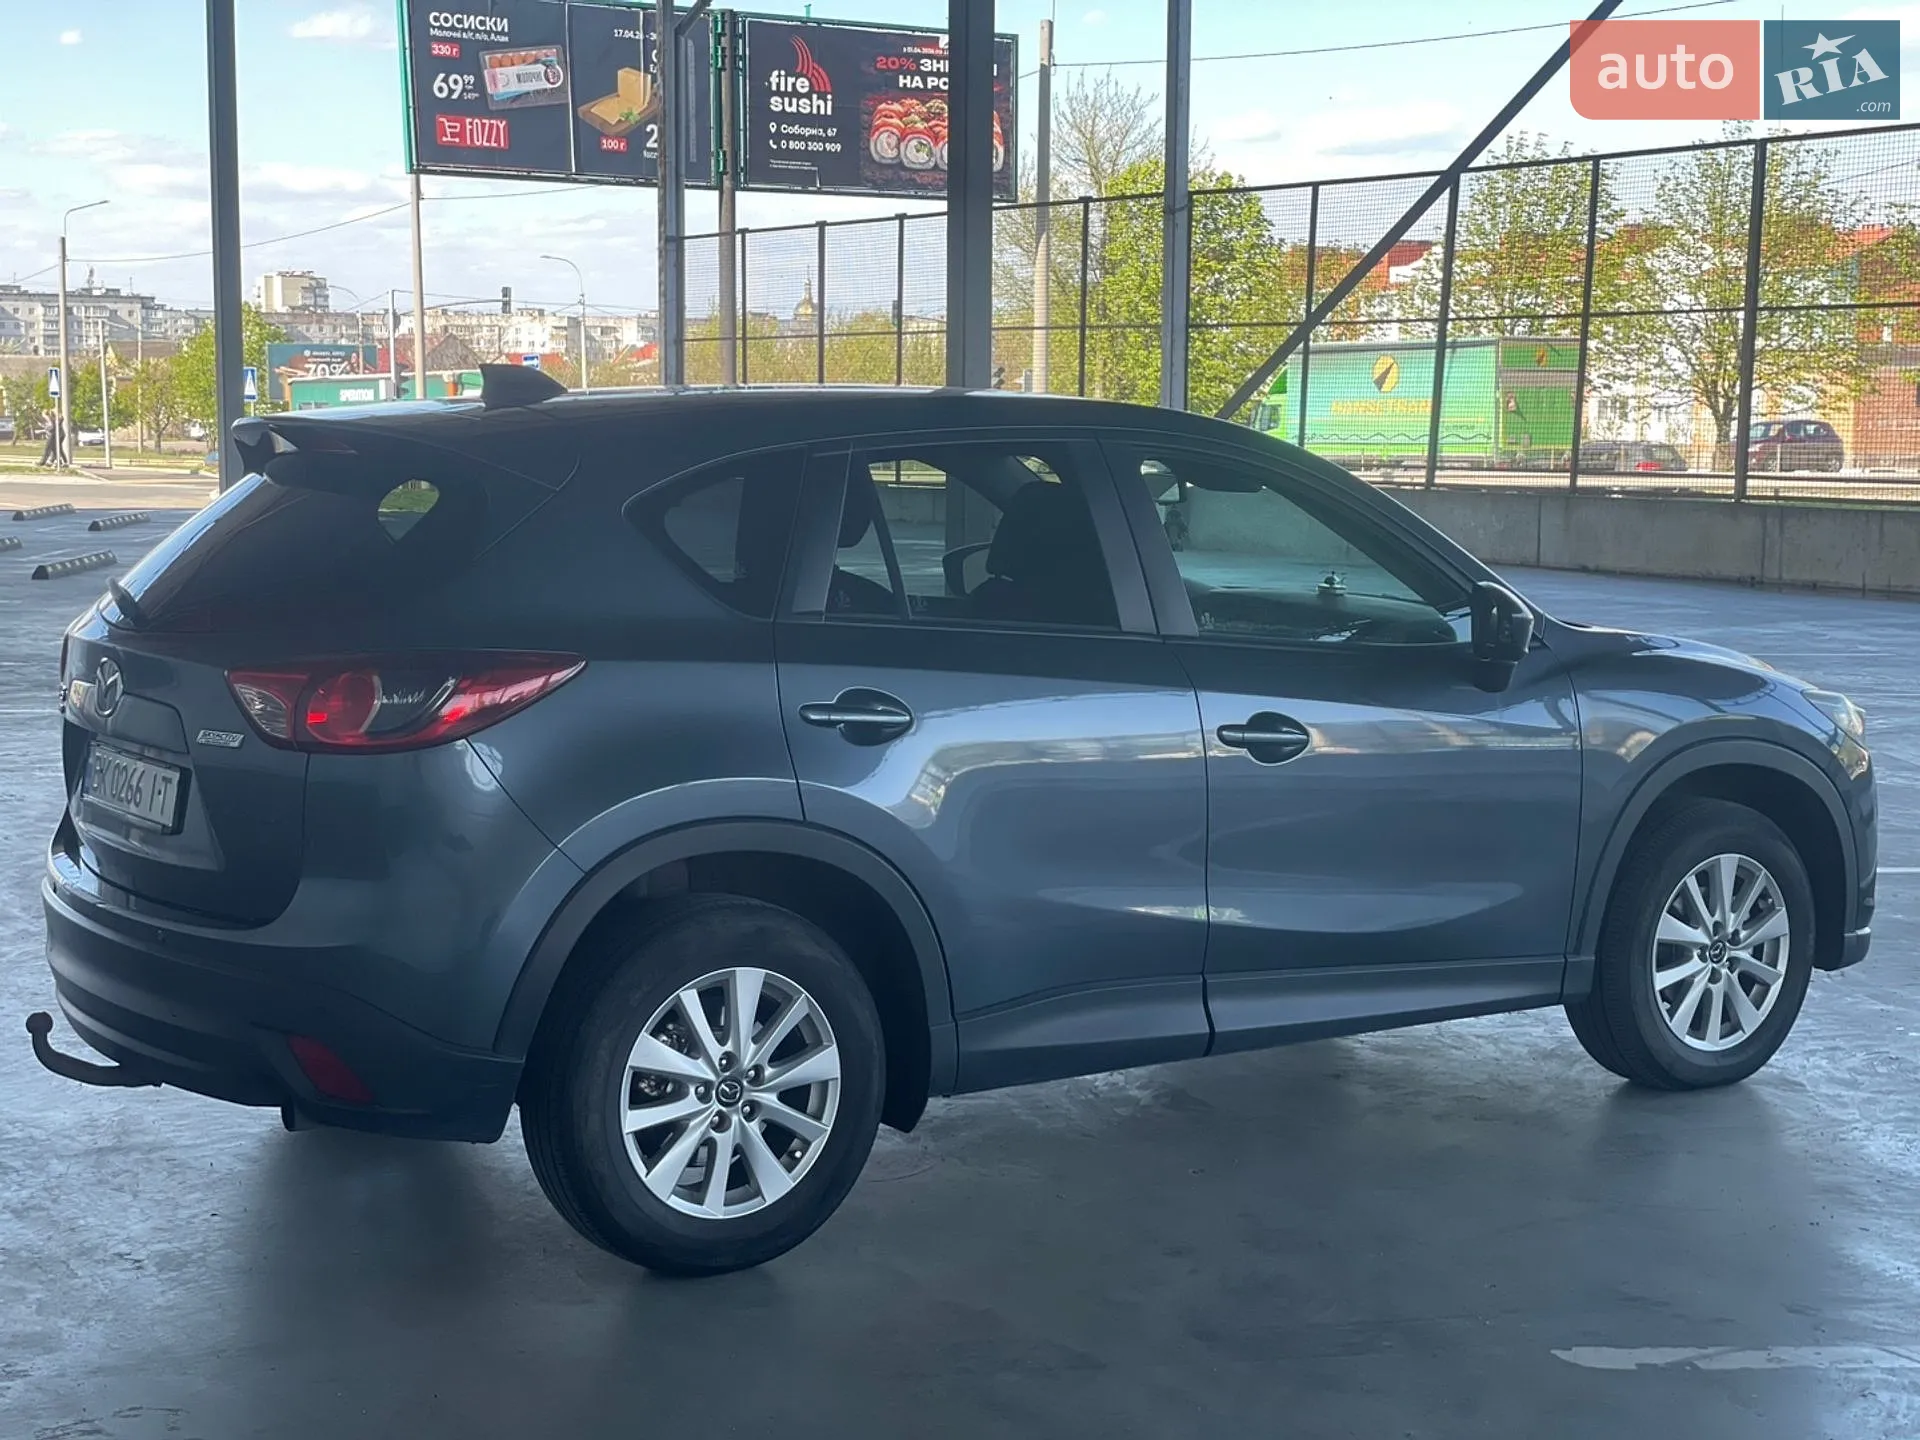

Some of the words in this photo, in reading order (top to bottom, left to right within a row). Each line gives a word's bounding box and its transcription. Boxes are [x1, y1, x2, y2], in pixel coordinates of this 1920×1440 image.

[429, 11, 509, 33] СОСИСКИ
[431, 43, 452, 56] 330
[876, 55, 917, 71] 20%
[433, 73, 463, 100] 69
[769, 69, 810, 94] fire
[898, 75, 924, 89] НА
[769, 93, 832, 116] sushi
[465, 117, 507, 147] FOZZY
[780, 124, 826, 138] Соборна,
[827, 127, 837, 137] 67
[601, 138, 619, 150] 100
[781, 140, 788, 149] 0
[788, 140, 805, 150] 800
[806, 141, 824, 151] 300
[825, 142, 842, 152] 909
[111, 760, 145, 808] 0266
[149, 773, 172, 816] IT
